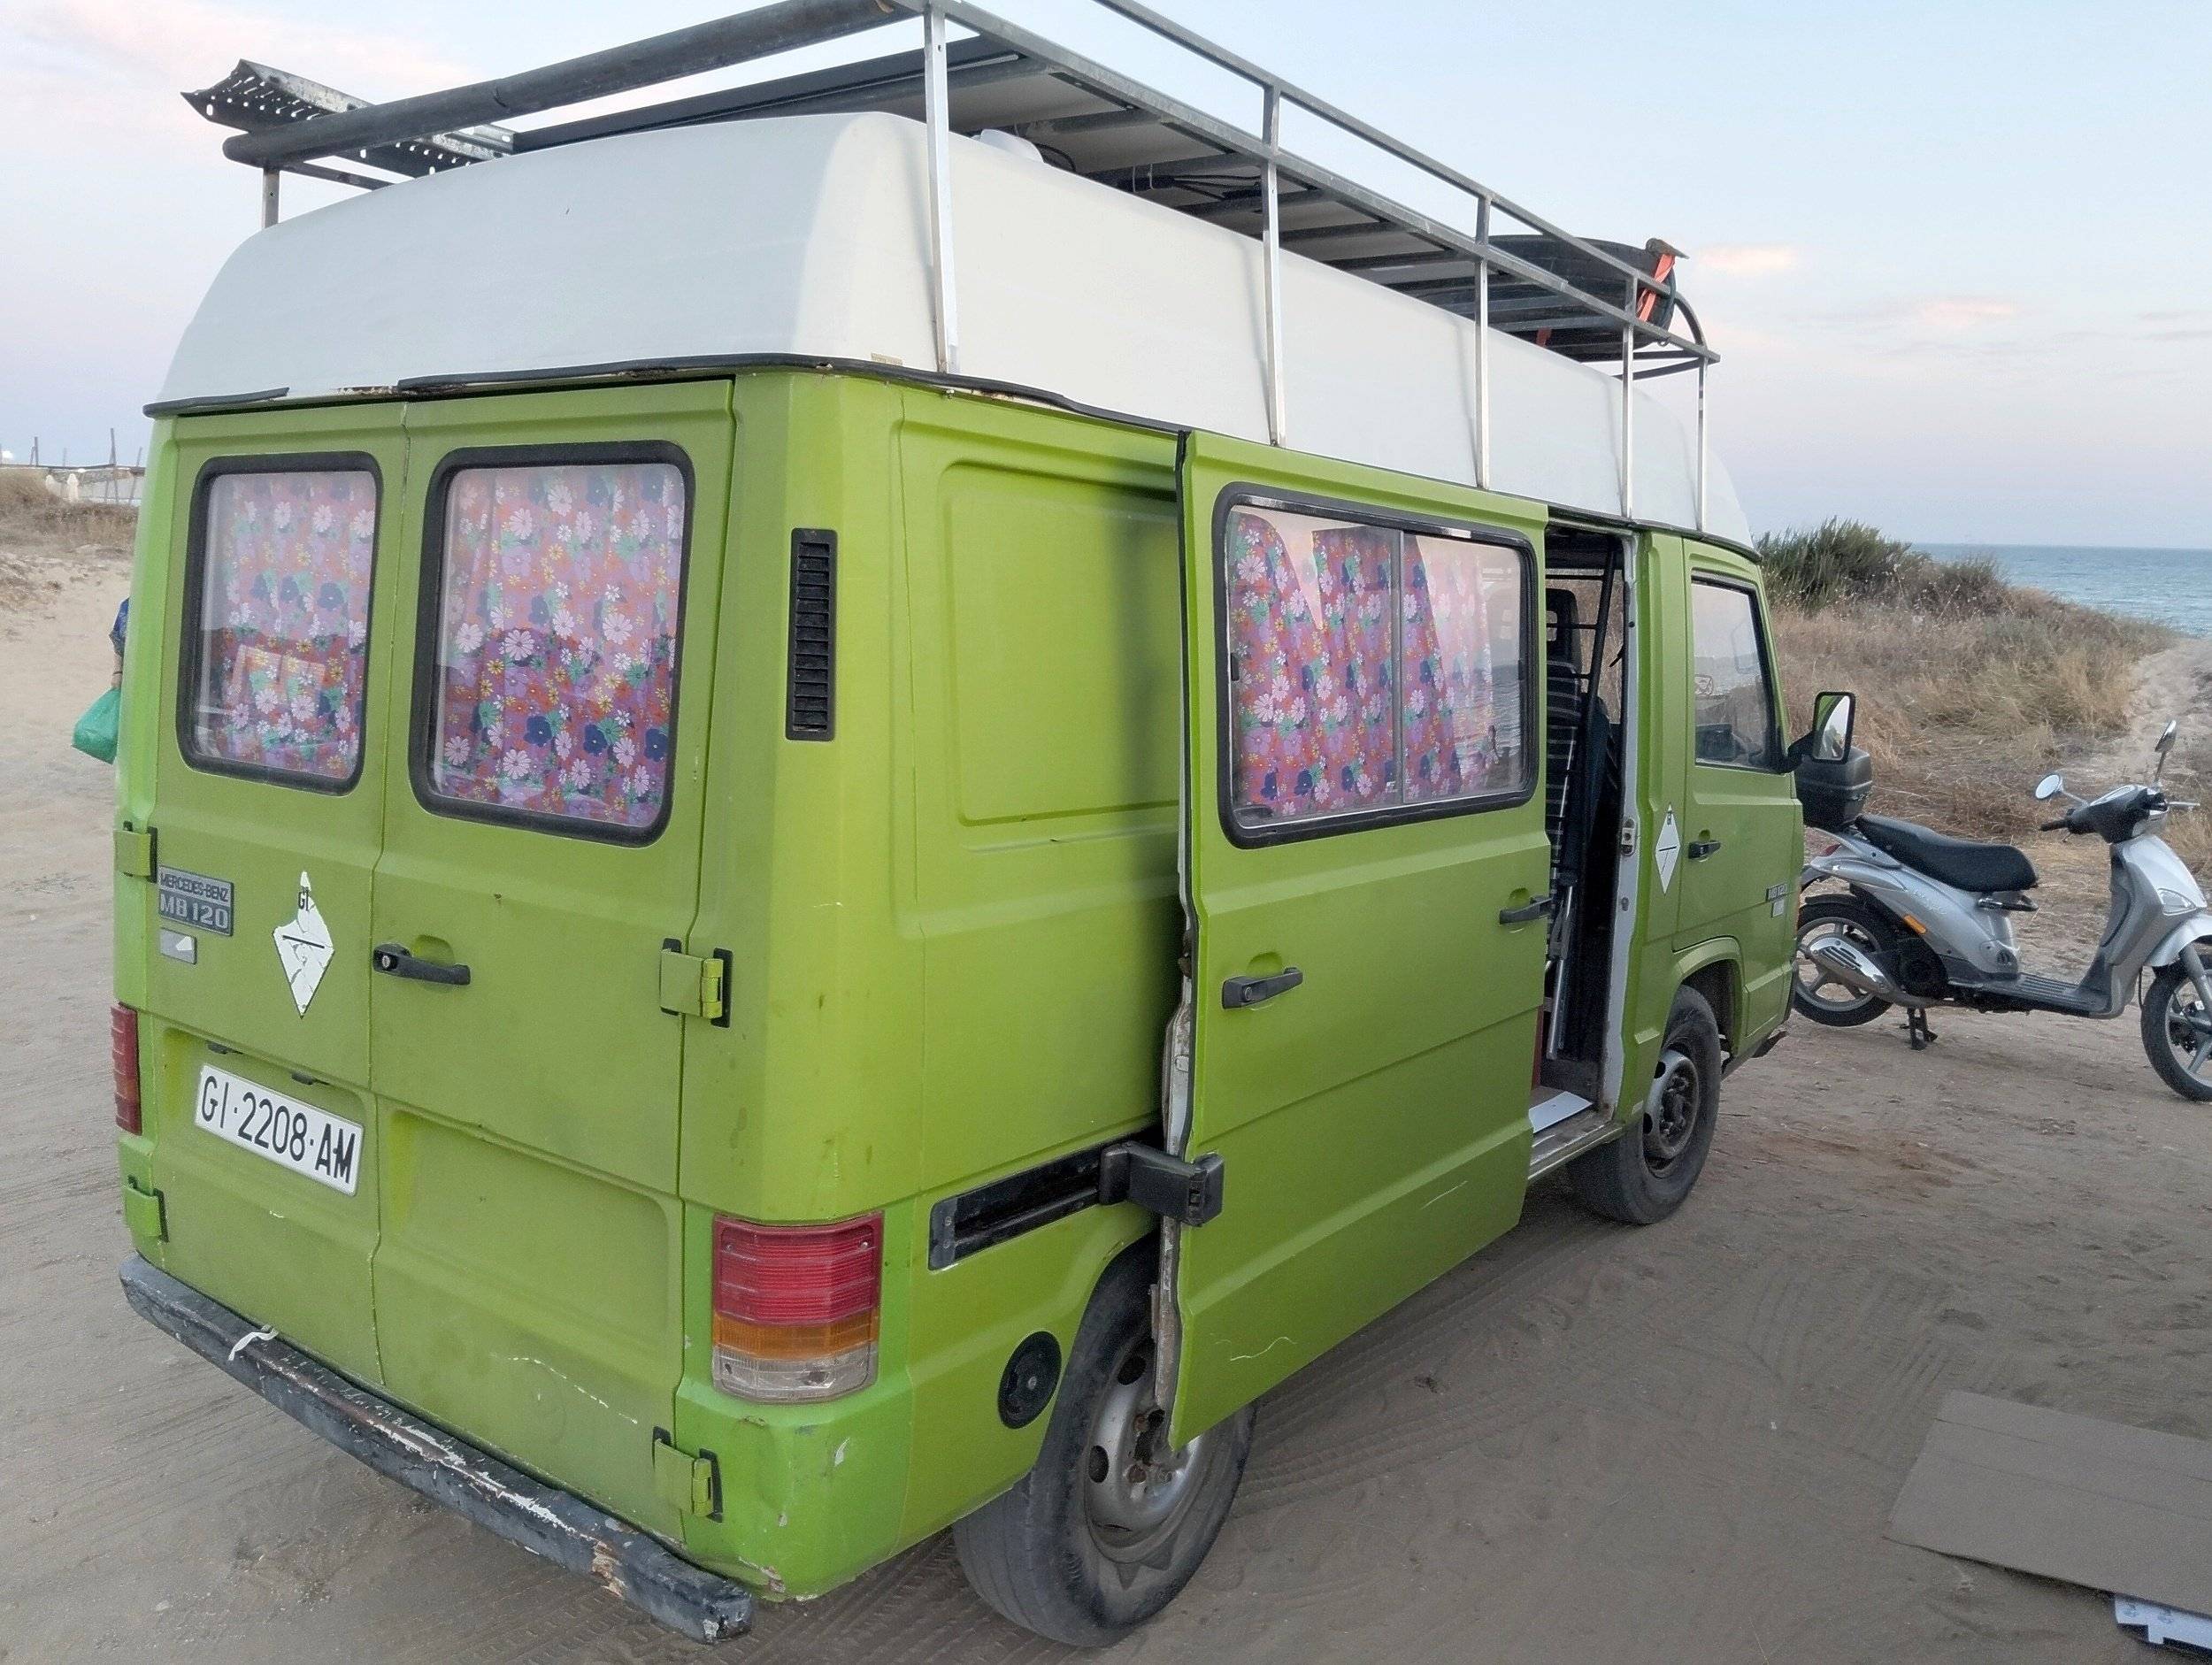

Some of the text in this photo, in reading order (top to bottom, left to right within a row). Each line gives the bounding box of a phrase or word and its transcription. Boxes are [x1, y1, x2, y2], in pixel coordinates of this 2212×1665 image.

[159, 872, 229, 902] MERCEDES-BENZ
[160, 894, 228, 929] MB 120
